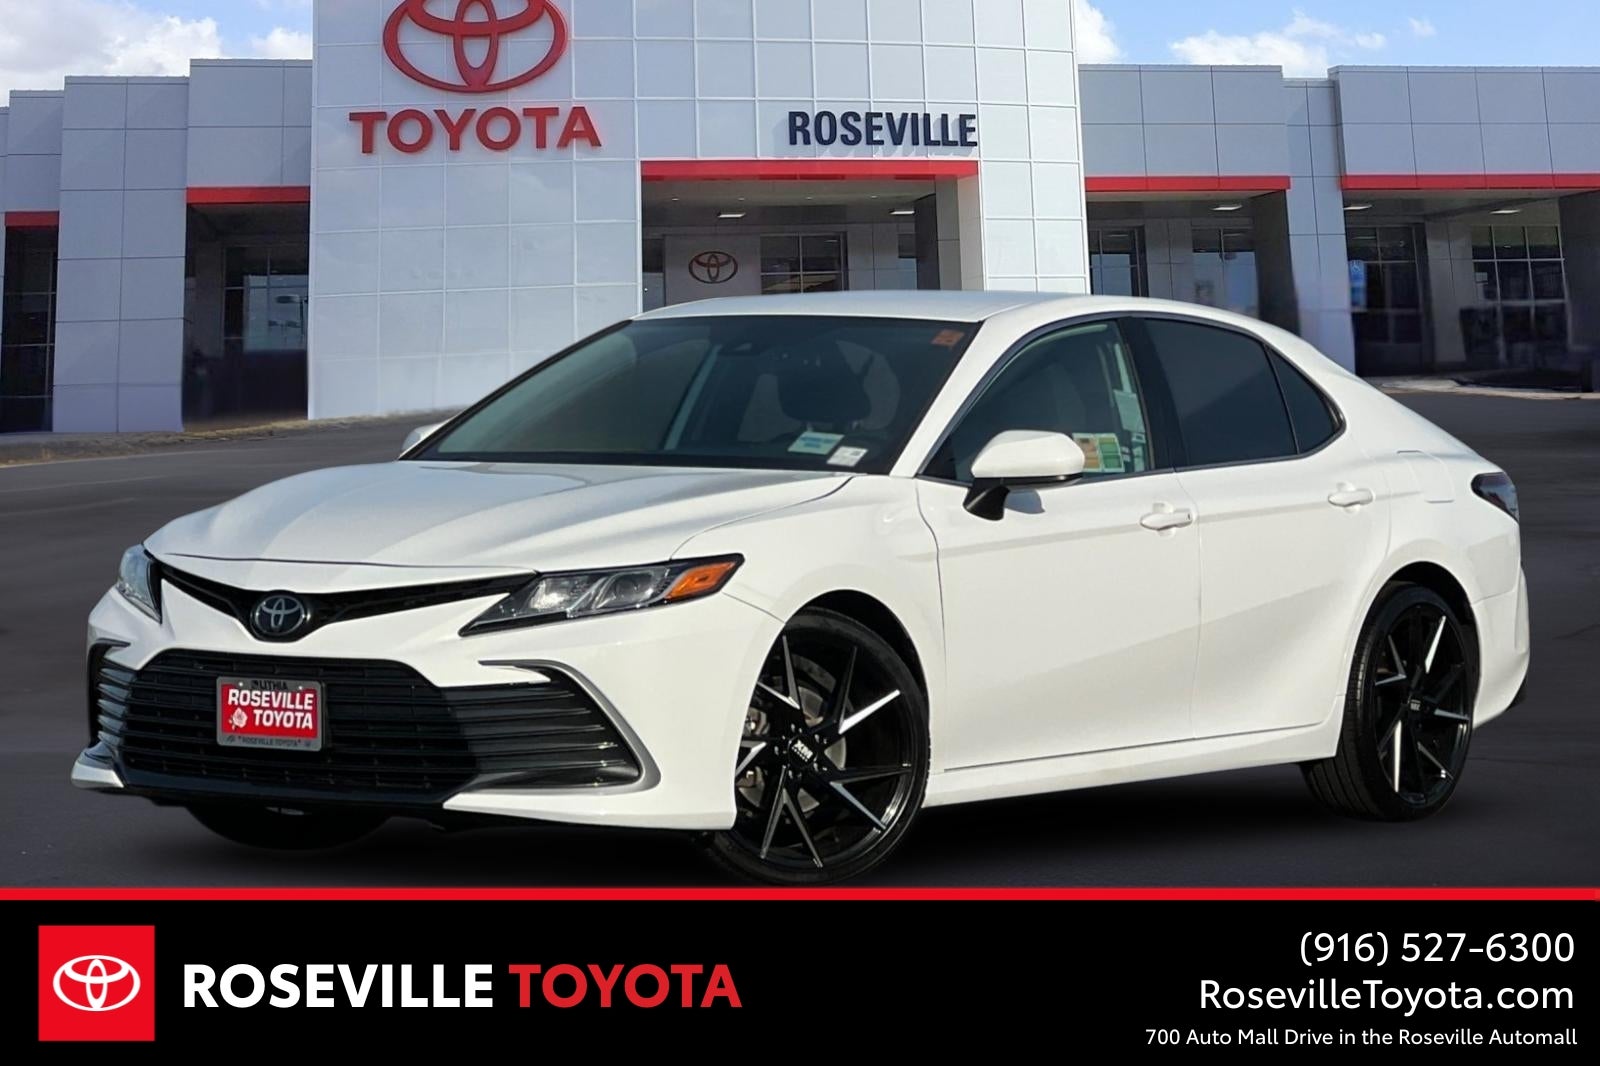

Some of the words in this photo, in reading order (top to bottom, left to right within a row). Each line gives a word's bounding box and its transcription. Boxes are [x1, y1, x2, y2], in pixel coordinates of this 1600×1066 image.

[349, 106, 602, 154] TOYOTA
[788, 111, 978, 147] ROSEVILLE
[228, 689, 314, 710] ROSEVILLE
[253, 709, 313, 730] TOYOTA
